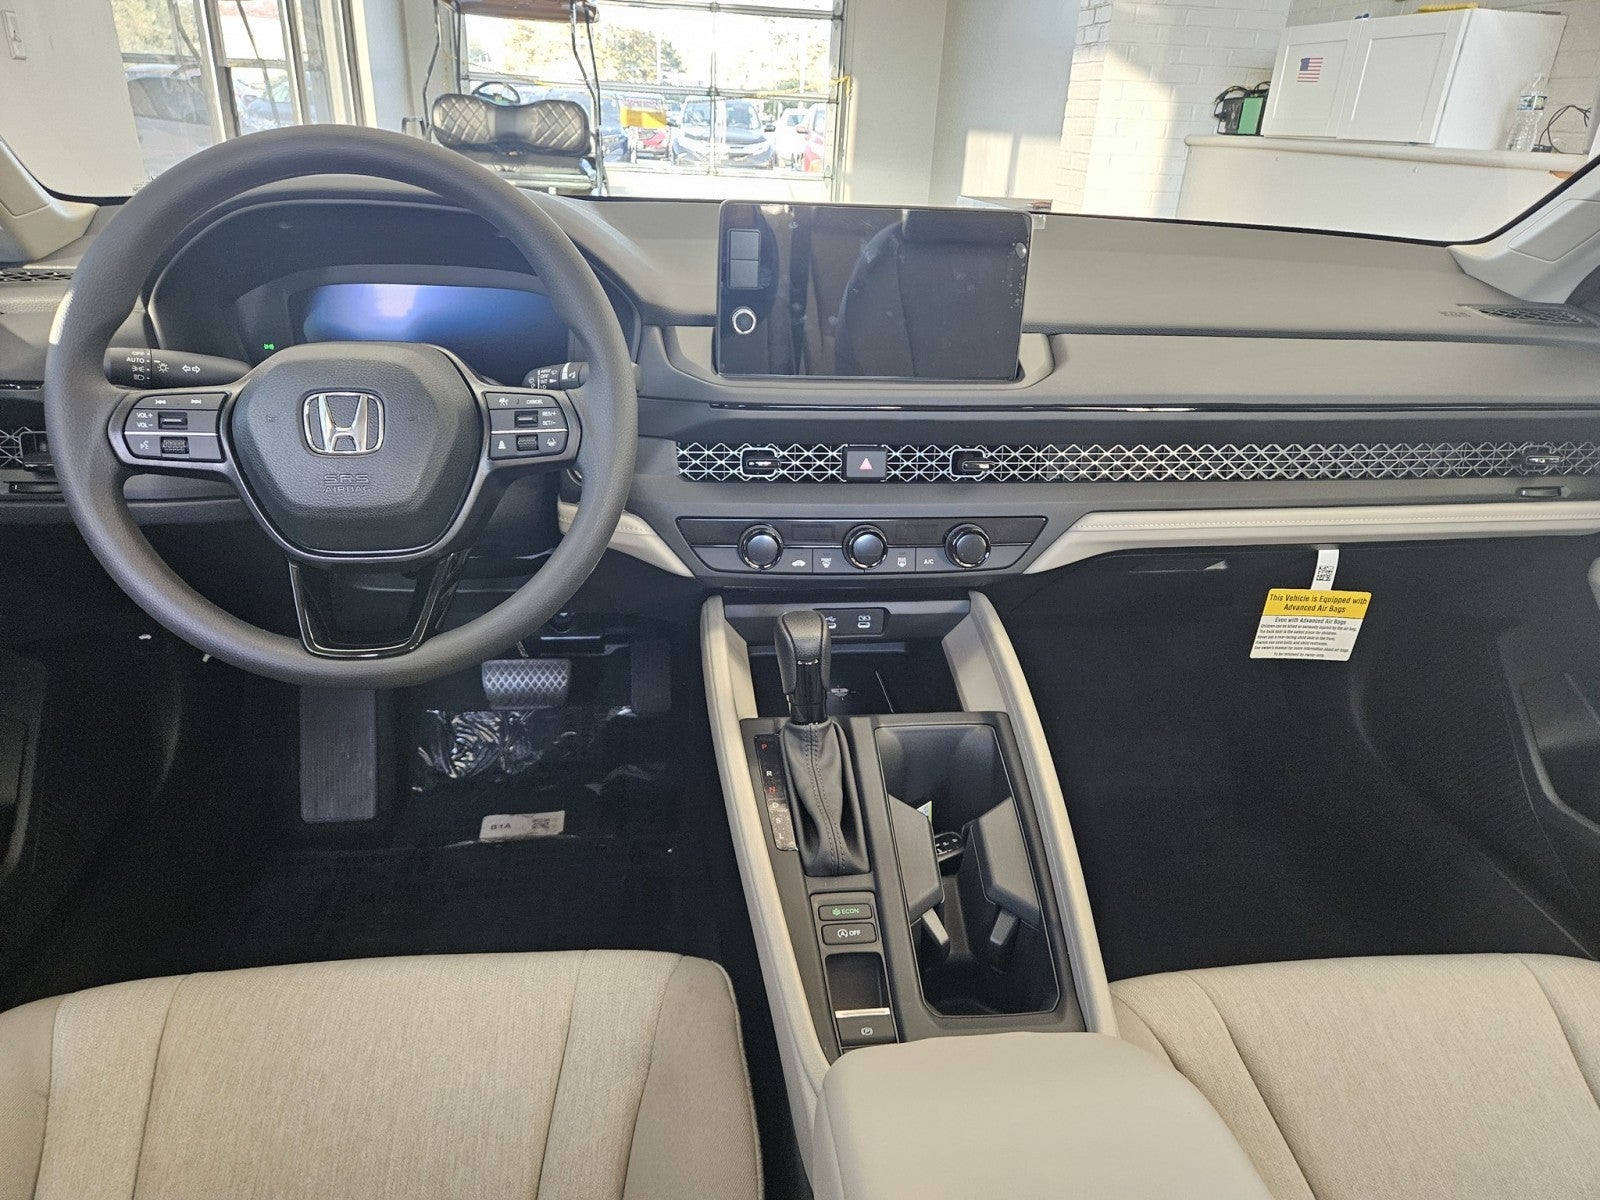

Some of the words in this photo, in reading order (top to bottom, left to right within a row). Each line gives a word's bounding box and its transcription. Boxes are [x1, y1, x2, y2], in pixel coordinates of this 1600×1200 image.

[126, 356, 145, 364] AUTO
[324, 473, 369, 483] SRS
[1269, 594, 1283, 602] This
[1286, 594, 1310, 602] Vehicle
[1319, 595, 1351, 604] Equipped
[1352, 597, 1367, 605] with
[1283, 603, 1316, 611] Advanced
[1317, 604, 1327, 612] Air
[1329, 605, 1346, 613] Bags
[768, 786, 776, 794] N
